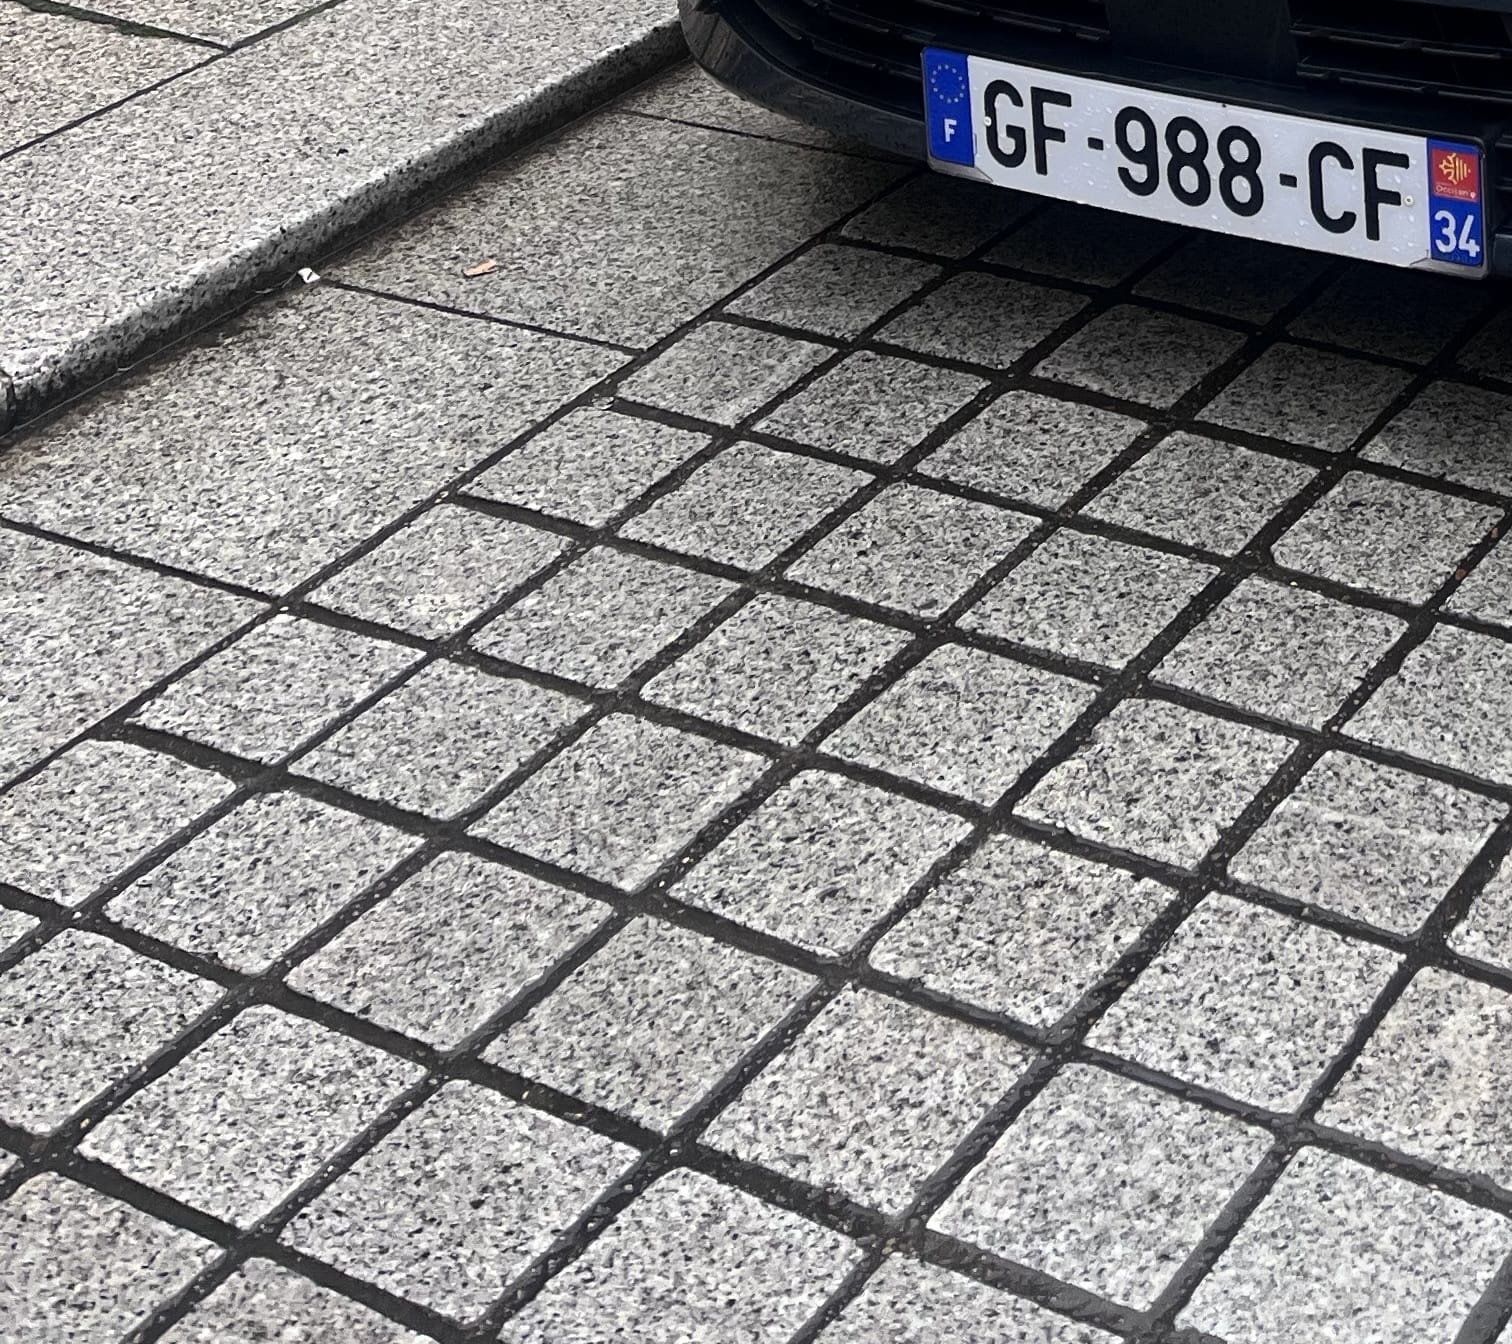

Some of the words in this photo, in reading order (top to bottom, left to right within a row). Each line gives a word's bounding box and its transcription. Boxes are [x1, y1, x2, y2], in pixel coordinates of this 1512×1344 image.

[944, 118, 958, 143] F
[984, 79, 1410, 241] GF-988-CF
[1434, 210, 1481, 258] 34
